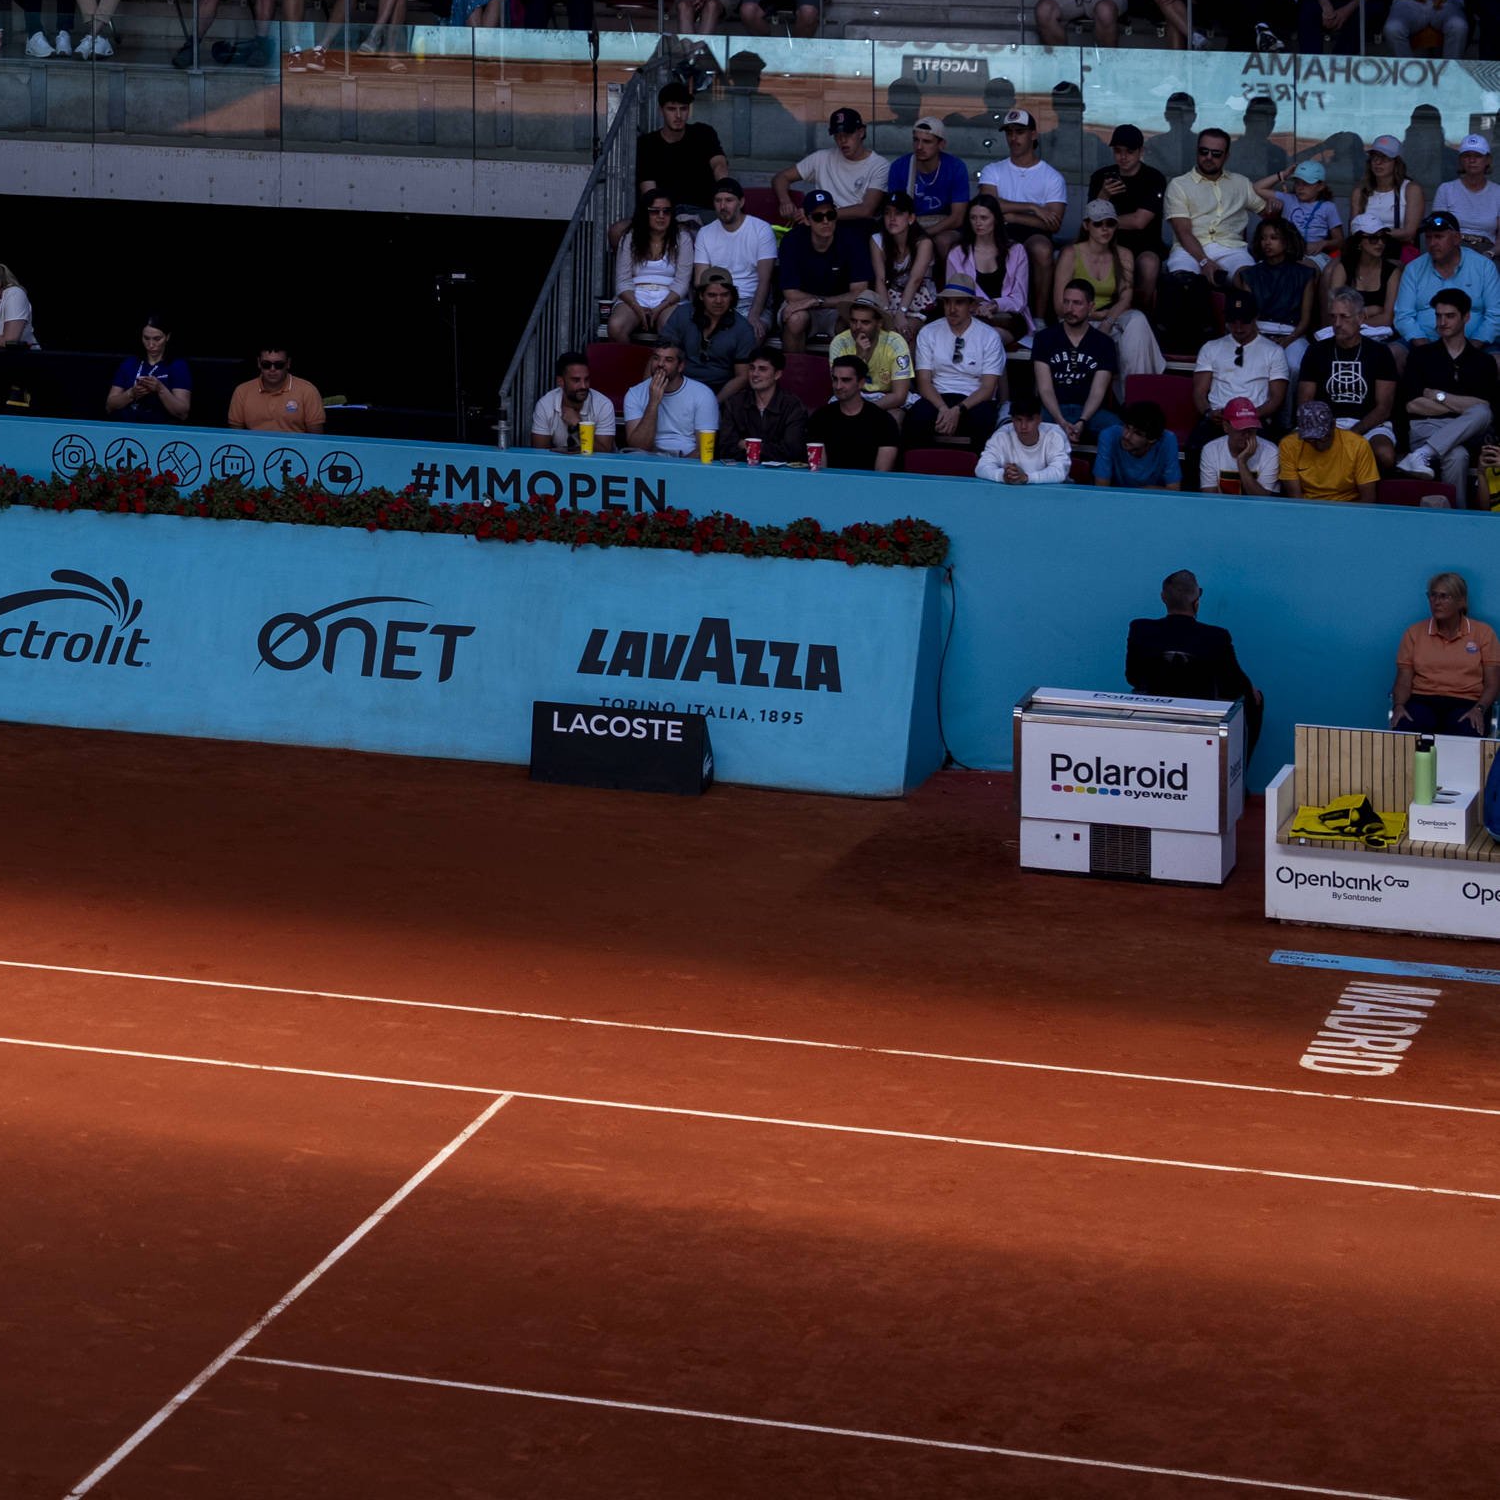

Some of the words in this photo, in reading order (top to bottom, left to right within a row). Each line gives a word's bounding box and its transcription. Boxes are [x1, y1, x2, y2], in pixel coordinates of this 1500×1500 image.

[411, 461, 667, 513] #MMOPEN
[552, 709, 685, 743] LACOSTE
[1050, 753, 1188, 791] Polaroid
[1124, 789, 1188, 801] eyewear
[1417, 818, 1448, 827] Openbank
[1276, 866, 1382, 892] Openbank
[1332, 892, 1342, 901] By
[1343, 892, 1382, 903] Santander
[1298, 980, 1442, 1077] MADRID
